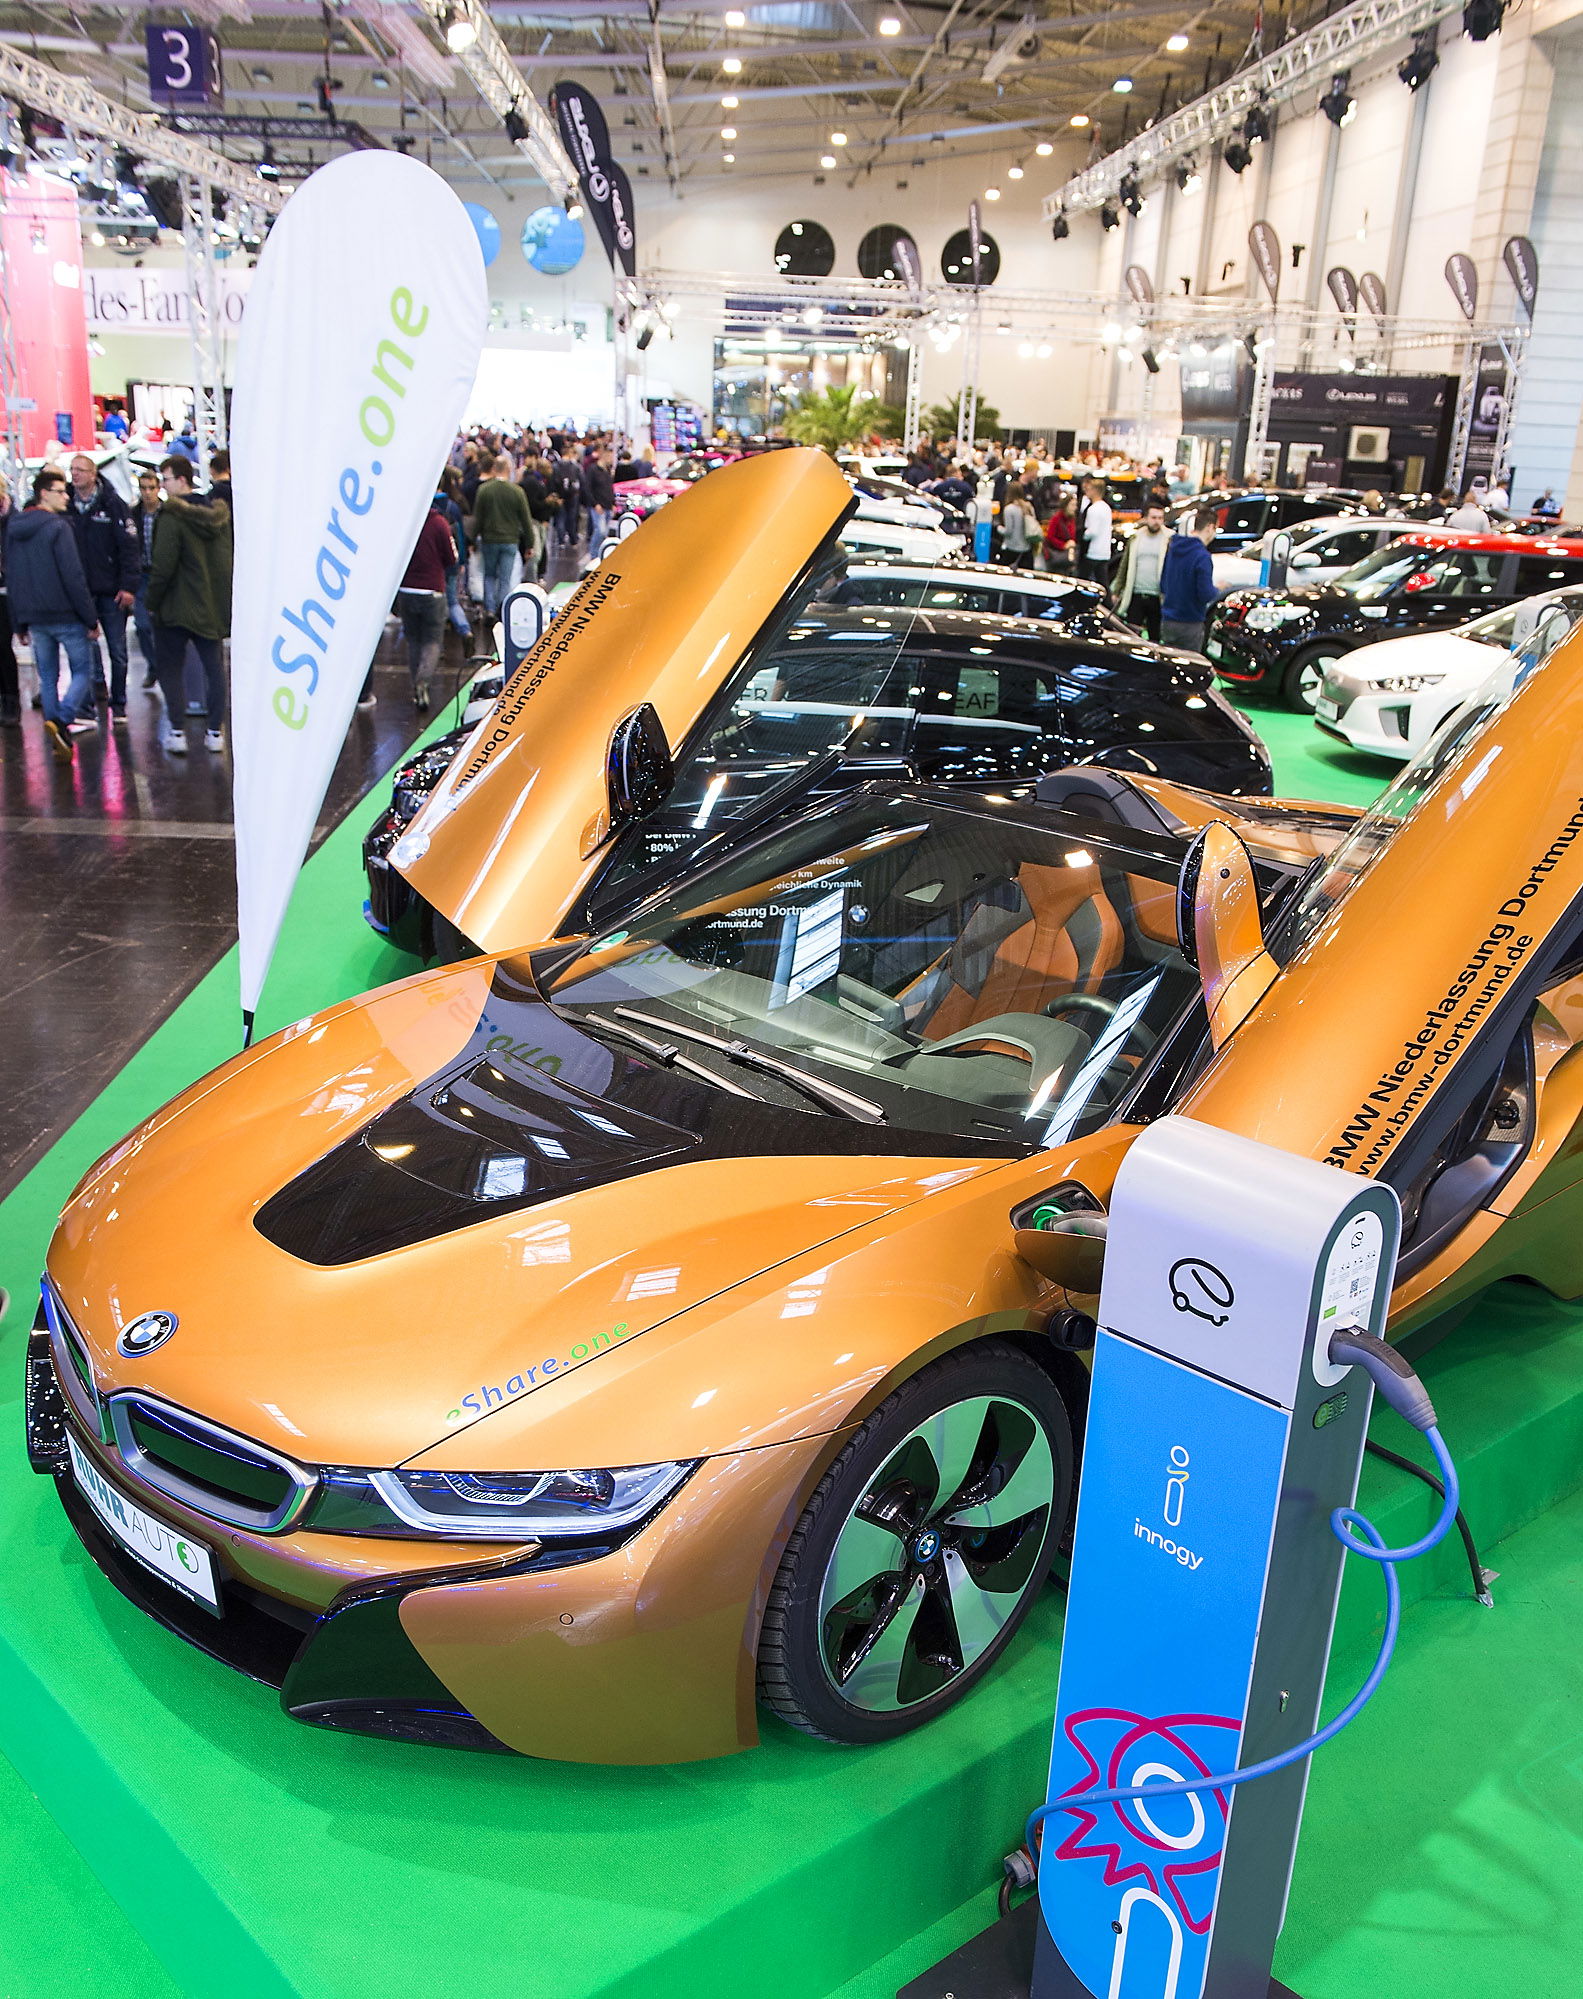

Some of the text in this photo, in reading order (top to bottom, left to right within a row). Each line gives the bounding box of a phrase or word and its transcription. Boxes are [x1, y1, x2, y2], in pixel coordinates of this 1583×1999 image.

[162, 30, 192, 89] 3
[85, 276, 248, 323] des-FanWo
[272, 286, 429, 731] eShare.one
[583, 573, 621, 616] BMW
[493, 571, 601, 716] www.bmw-dortmund.de
[500, 616, 591, 727] Niederlassung
[650, 843, 674, 852] 80%
[820, 880, 862, 890] Dynamik
[705, 919, 764, 928] ortmund.de
[1322, 1103, 1381, 1168] BMW
[1369, 922, 1516, 1103] Niederlassung
[1354, 933, 1534, 1177] www.bmw-dortmund.de
[446, 1322, 631, 1421] eShare.one
[1133, 1517, 1204, 1570] innogy
